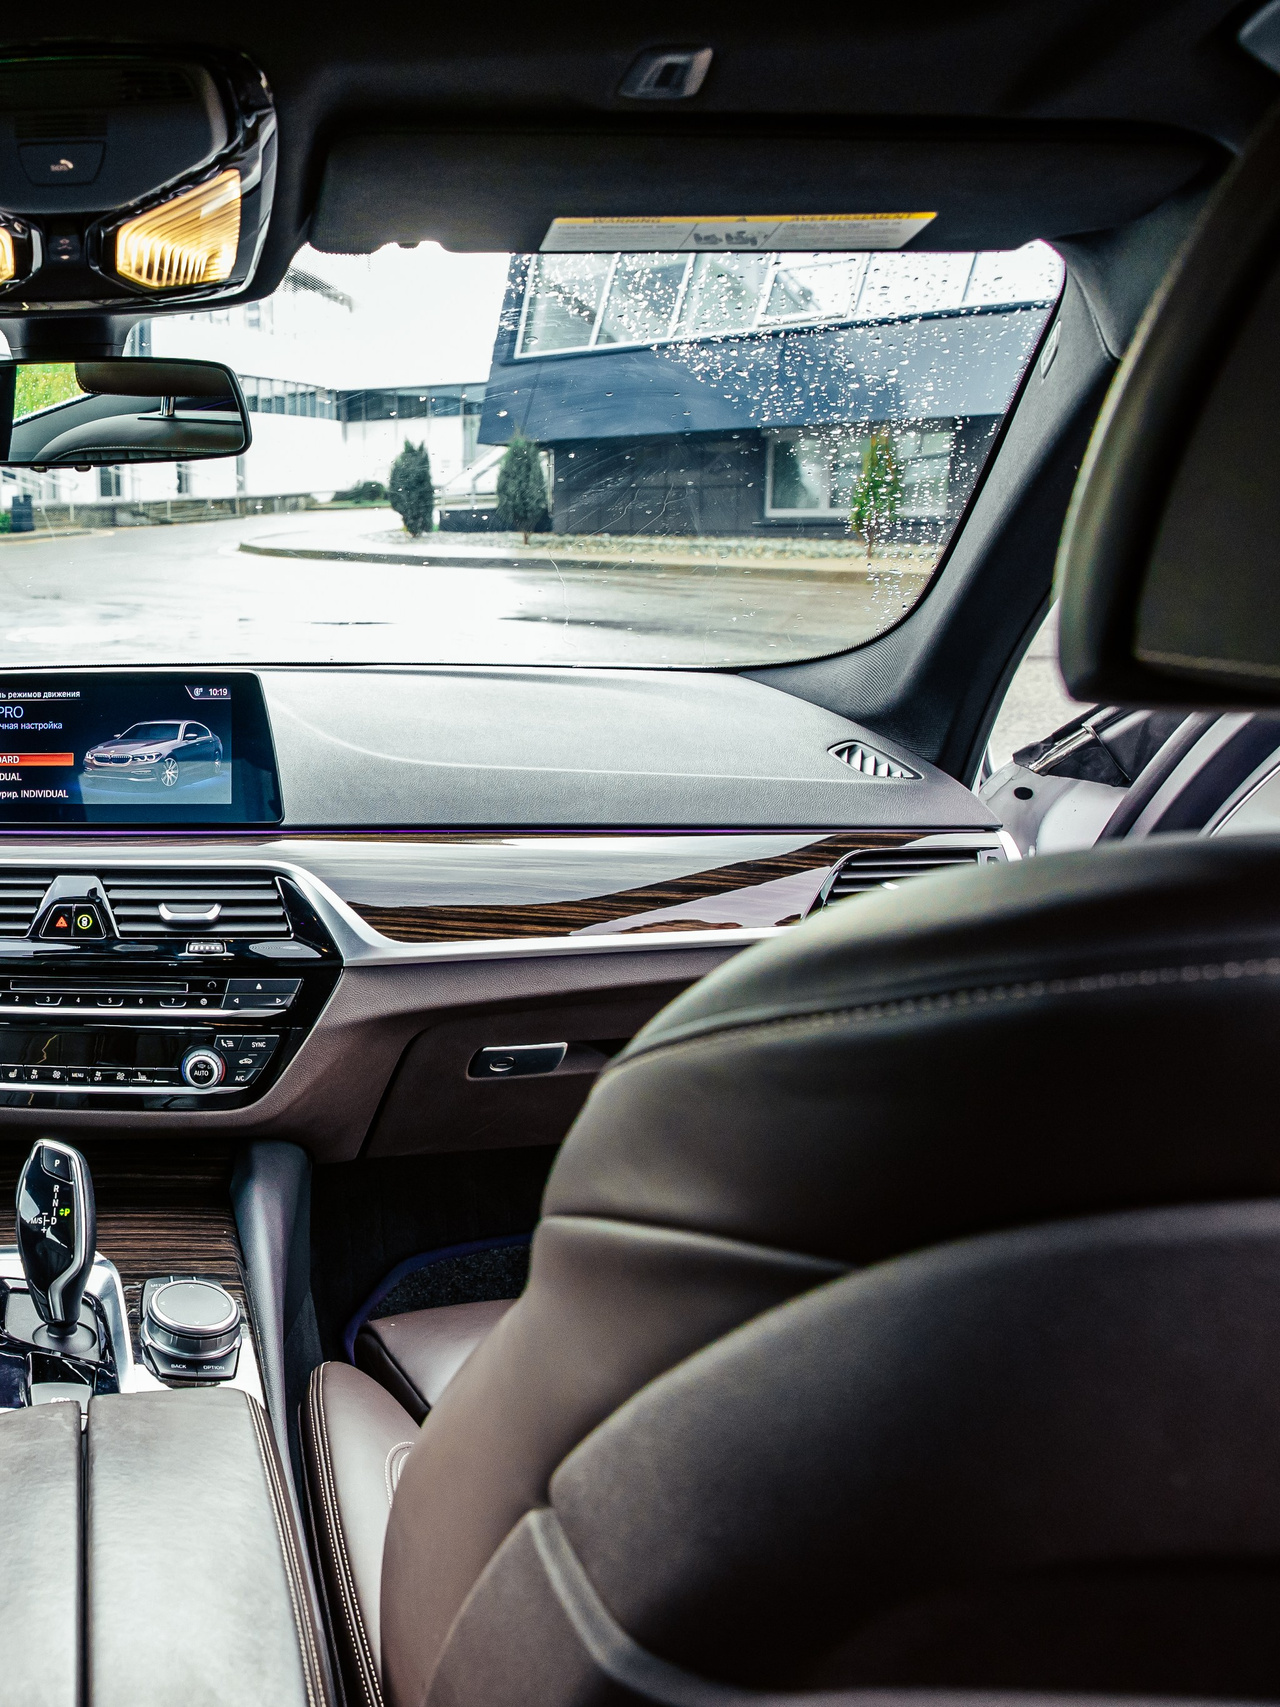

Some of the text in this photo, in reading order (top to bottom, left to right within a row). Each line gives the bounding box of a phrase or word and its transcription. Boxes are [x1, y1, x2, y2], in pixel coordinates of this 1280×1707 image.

[7, 691, 41, 700] режимов
[43, 691, 81, 699] движения
[208, 688, 228, 696] 10:19
[20, 720, 63, 731] настройка
[20, 789, 69, 798] INDIVIDUAL
[54, 1159, 60, 1167] P
[52, 1199, 59, 1207] N
[51, 1217, 57, 1225] D
